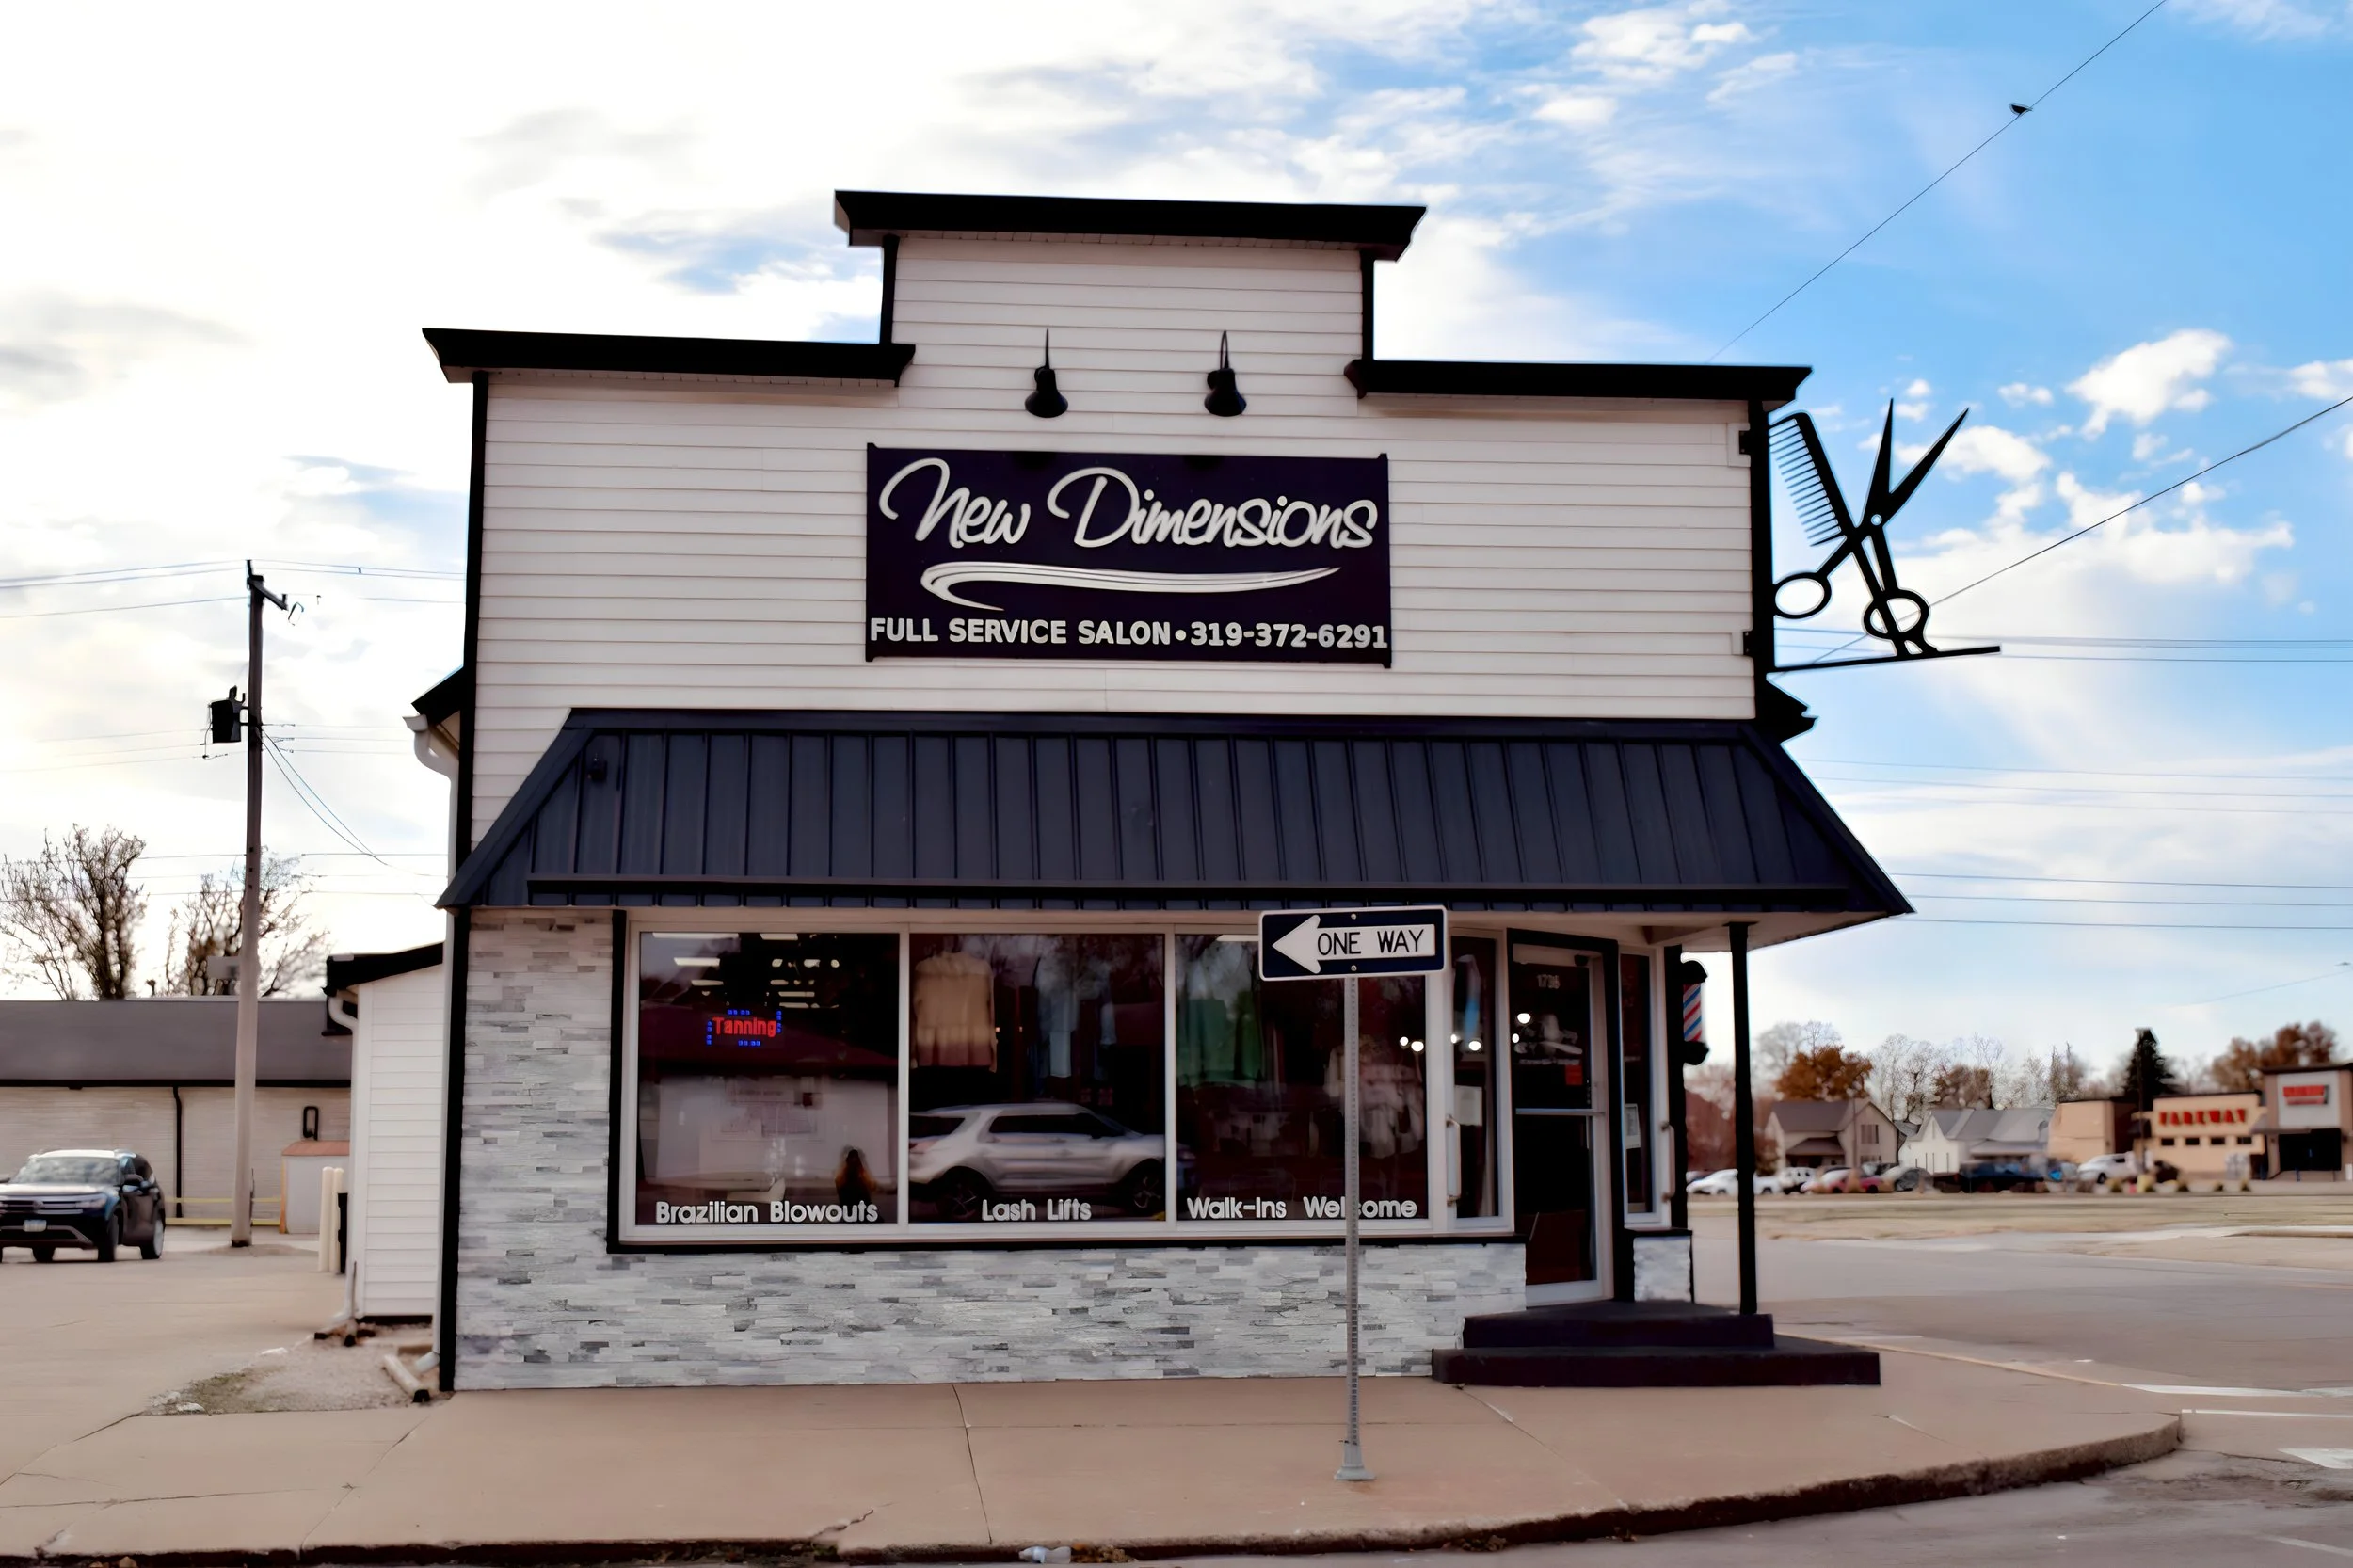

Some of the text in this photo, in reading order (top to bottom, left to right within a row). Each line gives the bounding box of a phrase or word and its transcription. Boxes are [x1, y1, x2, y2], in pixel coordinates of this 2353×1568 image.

[878, 457, 1379, 549] New Dimensions
[870, 617, 939, 642] FULL
[948, 617, 1067, 645] SERVICE
[1189, 621, 1389, 649] 319-372-6291
[1318, 928, 1424, 955] ONE WAY
[712, 1016, 776, 1037] Tanning
[656, 1200, 878, 1224] Brazilian Blowouts
[982, 1198, 1092, 1221] Lash Lifts
[1186, 1195, 1417, 1219] Walk-Ins Welome
